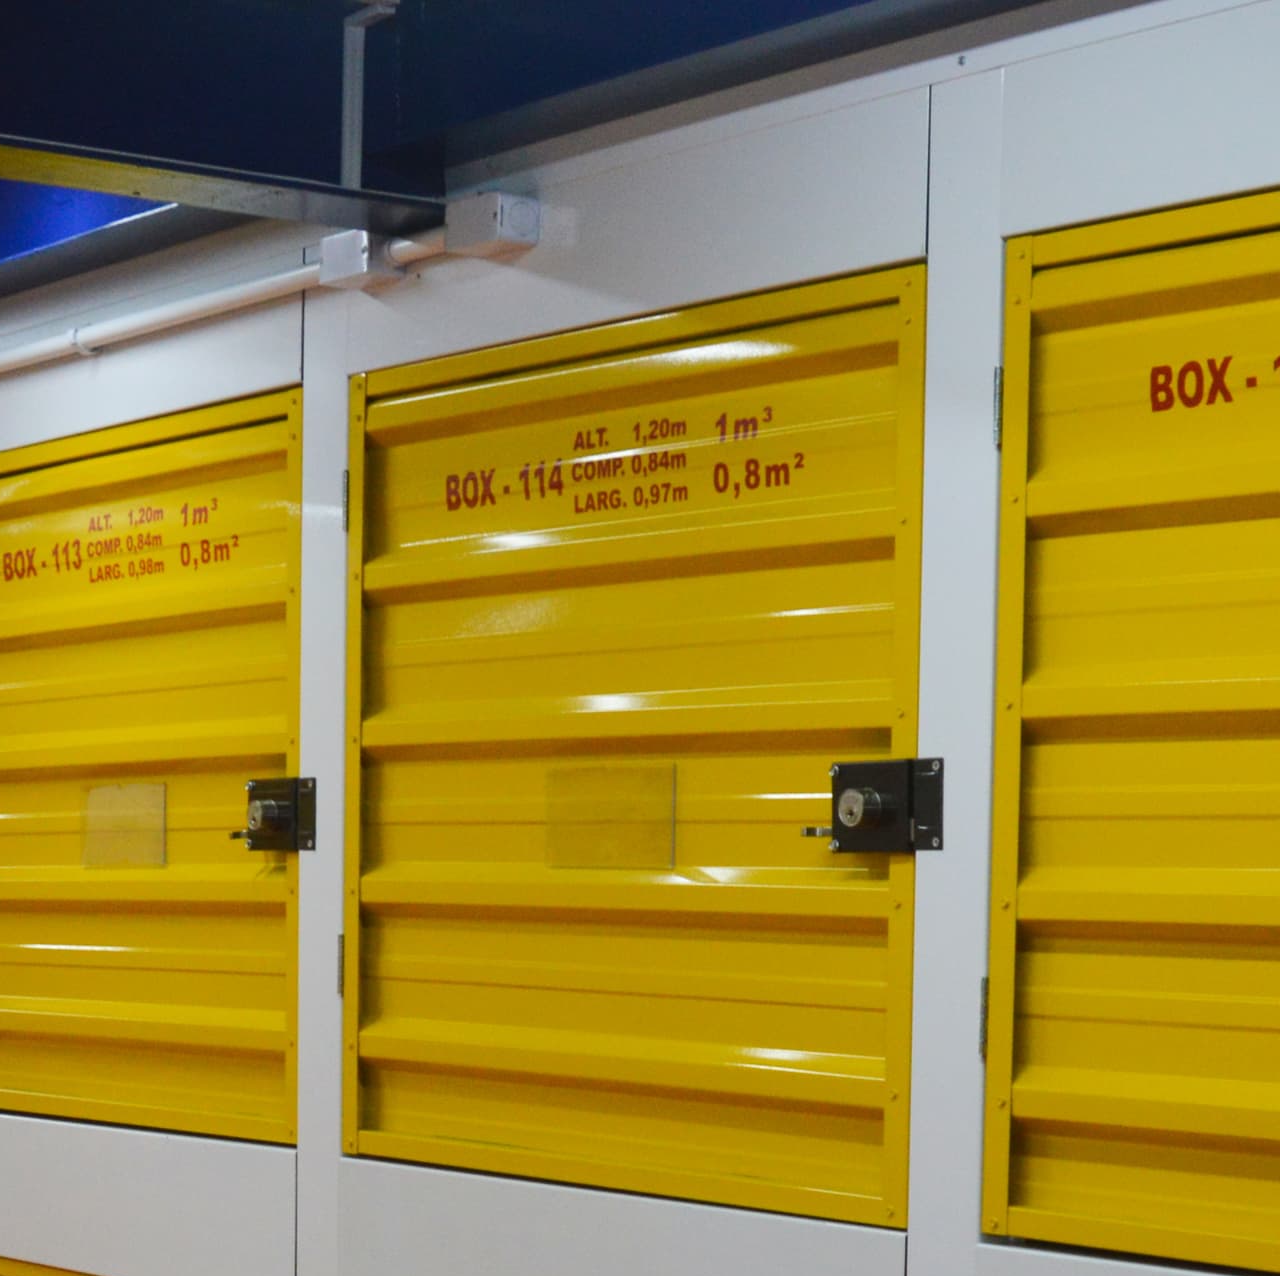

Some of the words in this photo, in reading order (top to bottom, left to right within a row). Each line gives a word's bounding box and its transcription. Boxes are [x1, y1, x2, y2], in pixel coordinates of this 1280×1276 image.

[1150, 355, 1233, 412] BOX
[573, 428, 609, 451] ALT.
[633, 418, 687, 446] 1,20m
[714, 406, 773, 442] 1m³
[571, 459, 625, 482] COMP.
[631, 449, 687, 476] 0,84m
[445, 468, 496, 511] BOX
[519, 458, 564, 500] 114
[574, 491, 627, 514] LARG.
[633, 482, 688, 508] 0,97m
[88, 514, 113, 533] ALT.
[128, 506, 164, 528] 1,20m
[3, 547, 38, 582] BOX
[52, 539, 82, 574] 113
[87, 539, 123, 558] COMP.
[126, 533, 163, 554] 0,84m
[89, 563, 125, 584] LARG.
[128, 559, 165, 581] 0,98m
